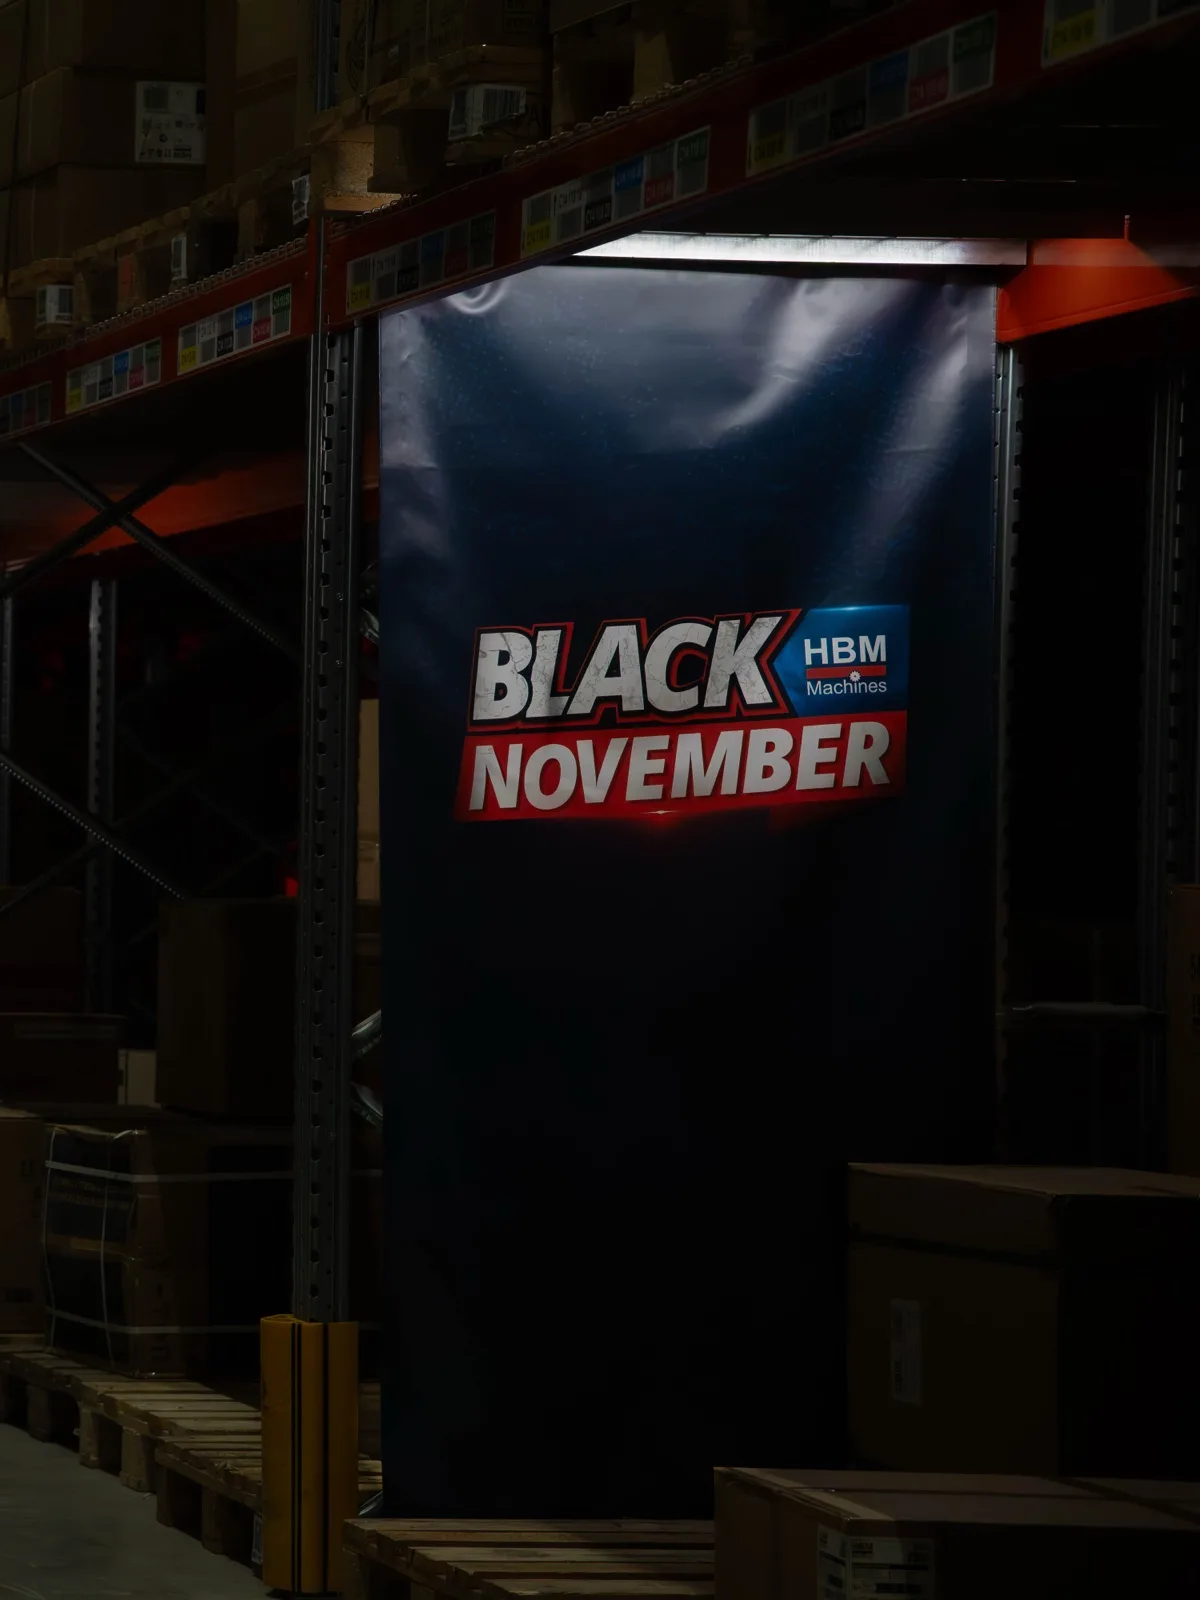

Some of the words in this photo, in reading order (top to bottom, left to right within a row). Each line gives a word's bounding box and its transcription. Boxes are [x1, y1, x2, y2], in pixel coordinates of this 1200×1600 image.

[472, 615, 783, 721] BLACK
[804, 634, 887, 666] HBM
[806, 678, 888, 696] Machines
[469, 721, 890, 811] NOVEMBER
